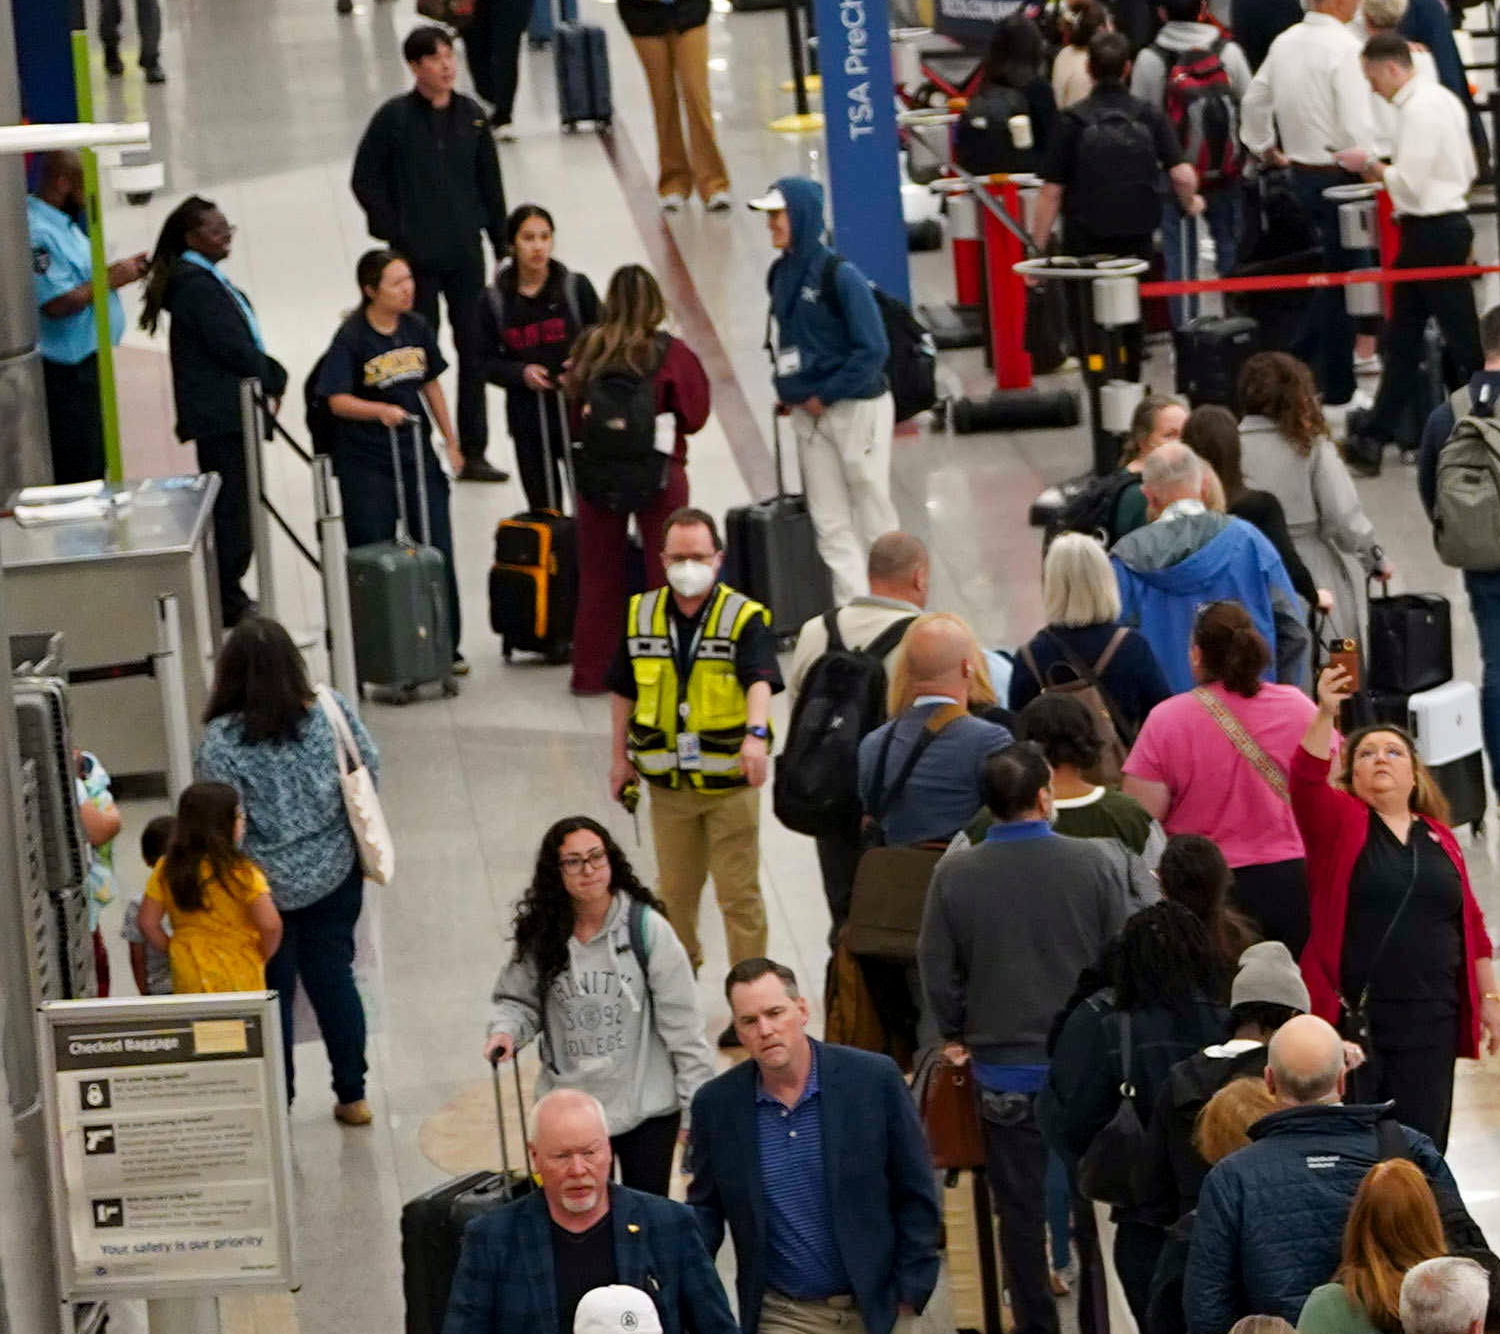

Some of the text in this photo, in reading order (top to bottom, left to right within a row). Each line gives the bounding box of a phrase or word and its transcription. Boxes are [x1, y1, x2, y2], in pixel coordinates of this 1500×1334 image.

[847, 81, 875, 142] TSA
[553, 971, 632, 1004] RINITY
[68, 1035, 180, 1057] Checked Baggage
[101, 1232, 264, 1257] Your safety is our priority
